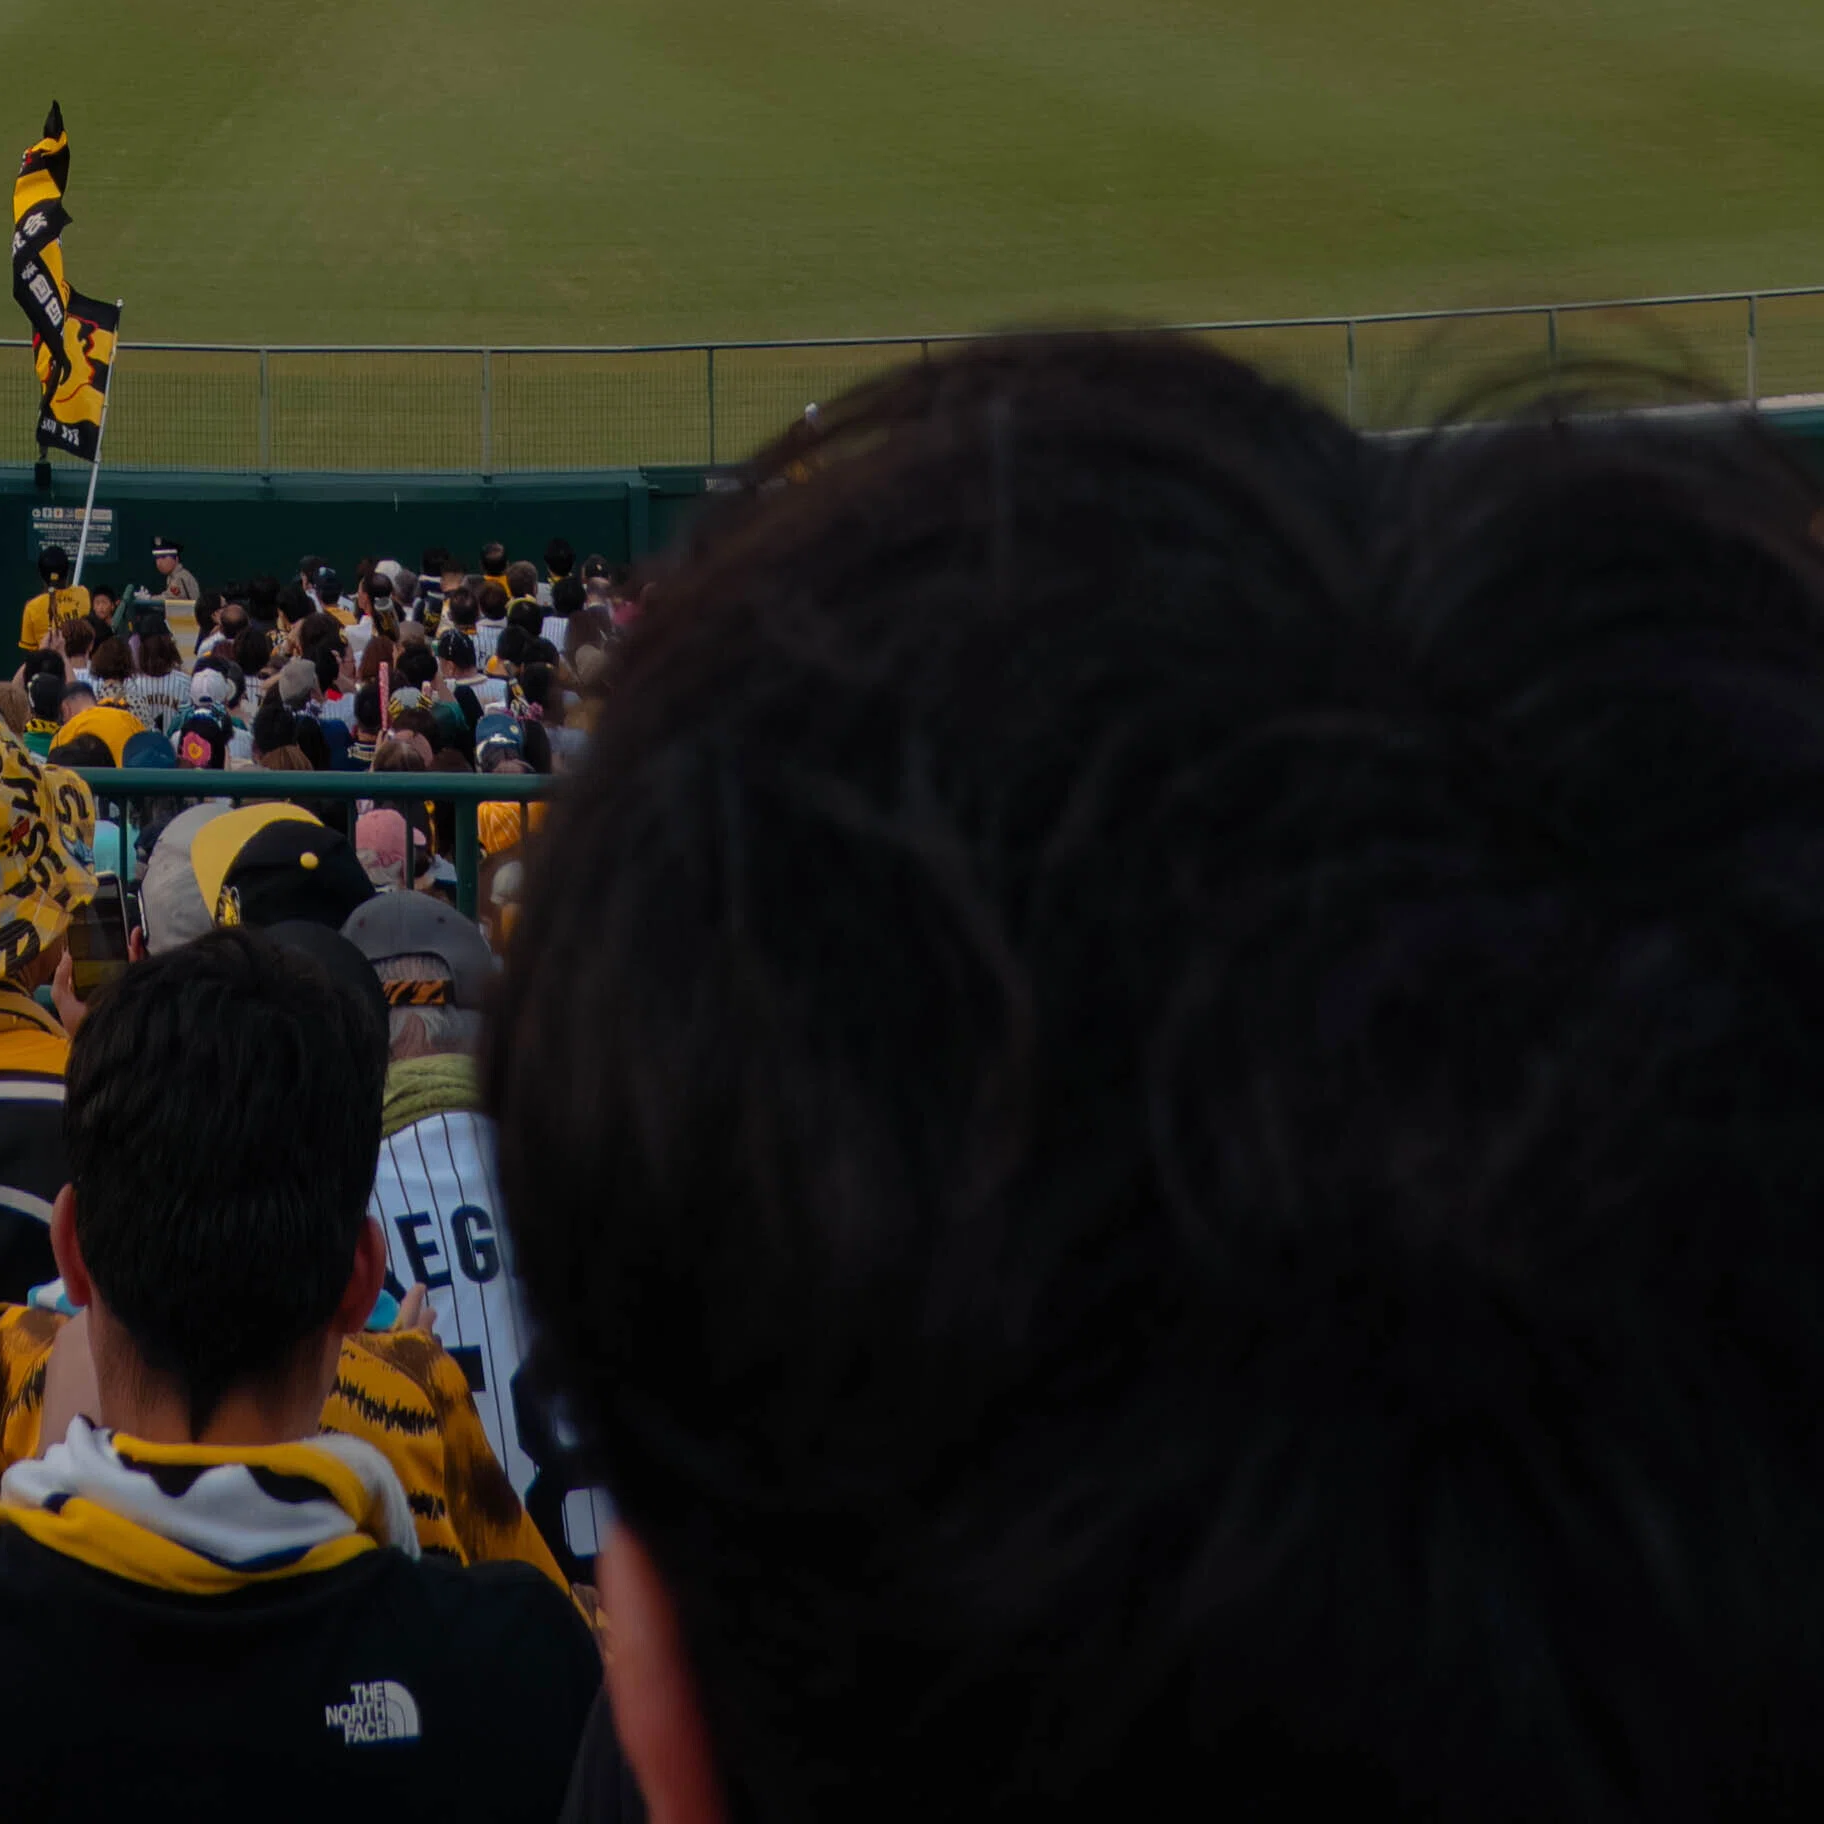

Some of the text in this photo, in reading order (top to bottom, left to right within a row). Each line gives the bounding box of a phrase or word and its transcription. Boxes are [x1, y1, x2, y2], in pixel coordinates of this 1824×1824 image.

[349, 1680, 385, 1704] THE
[324, 1702, 387, 1728] NORTH
[344, 1721, 389, 1745] FACE
